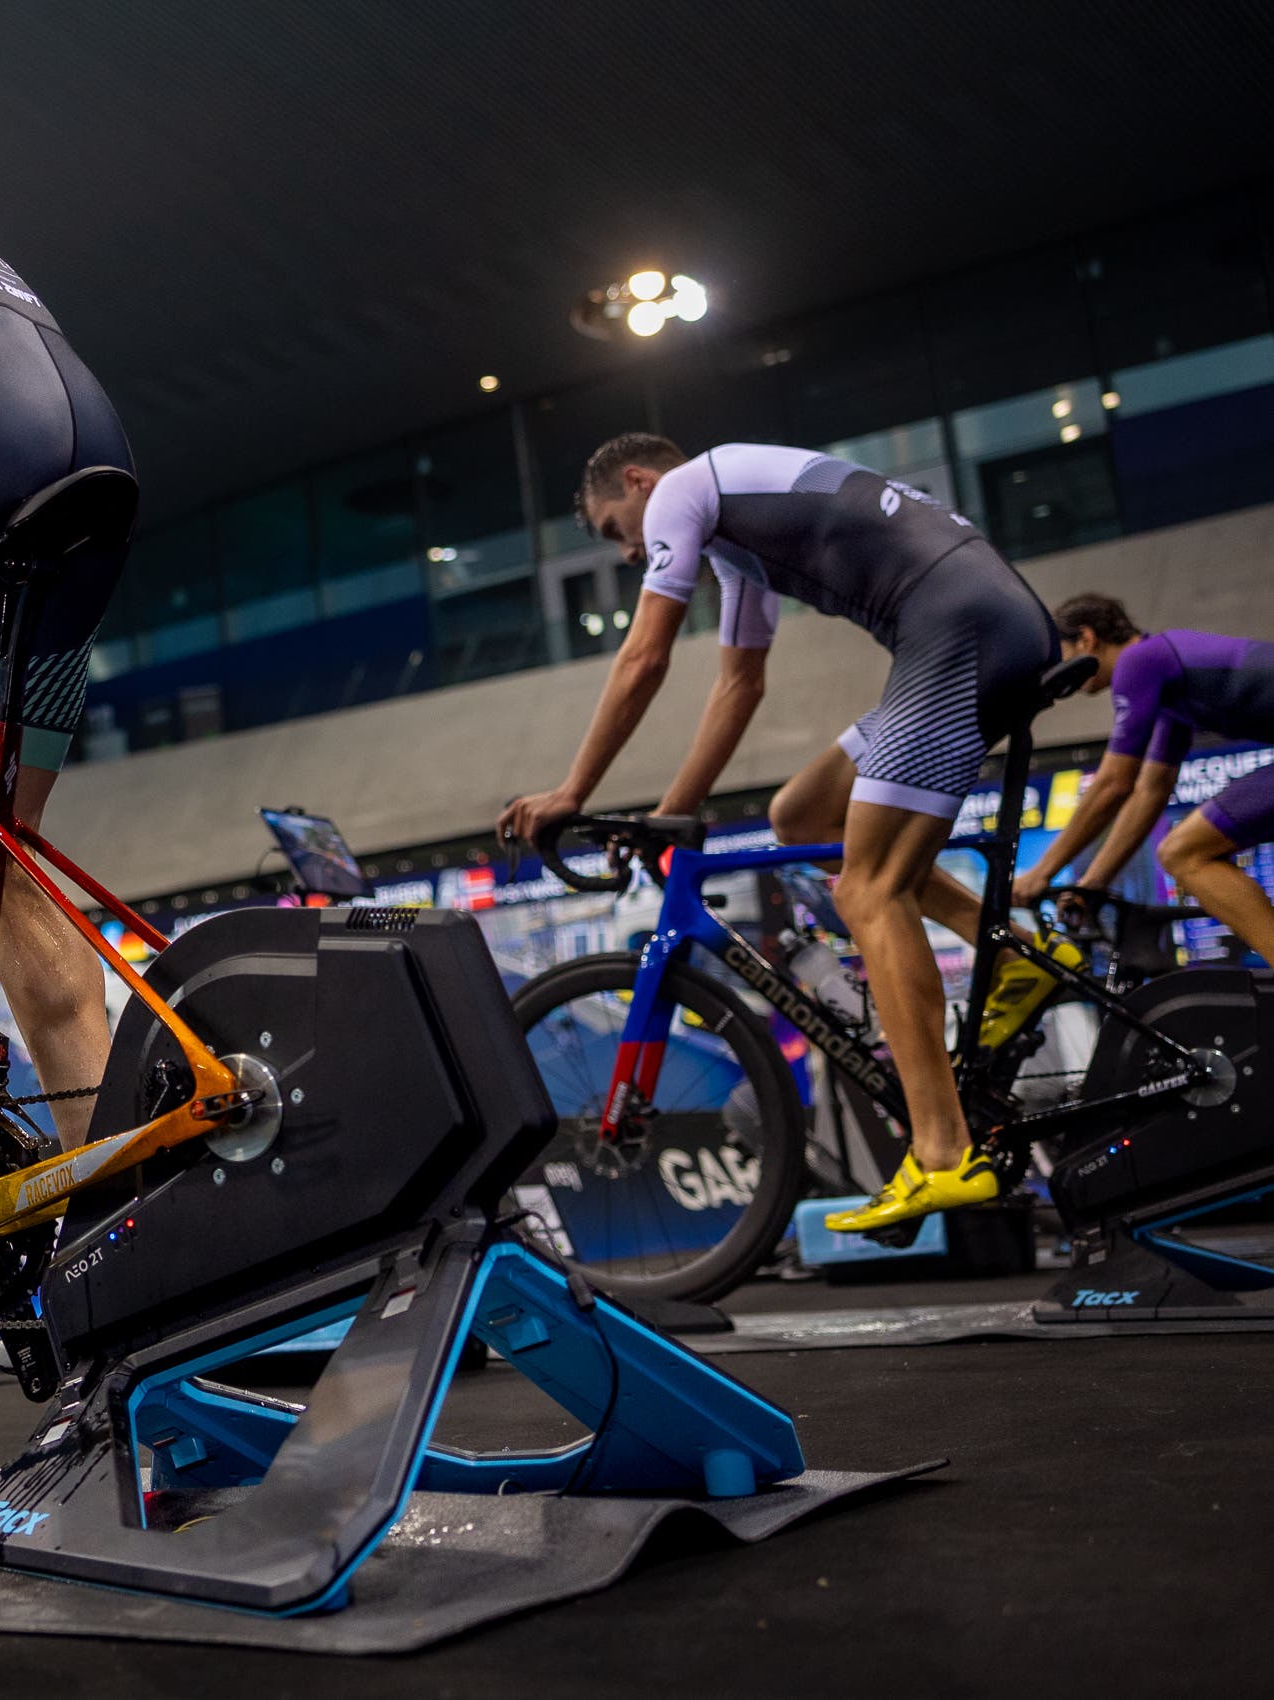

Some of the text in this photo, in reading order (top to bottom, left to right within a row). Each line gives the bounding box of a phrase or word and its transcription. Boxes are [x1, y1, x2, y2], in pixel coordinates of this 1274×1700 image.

[725, 945, 888, 1093] cannondale
[25, 1163, 76, 1207] RACEVOX
[89, 1247, 104, 1267] 2T
[1071, 1289, 1140, 1307] Tacx
